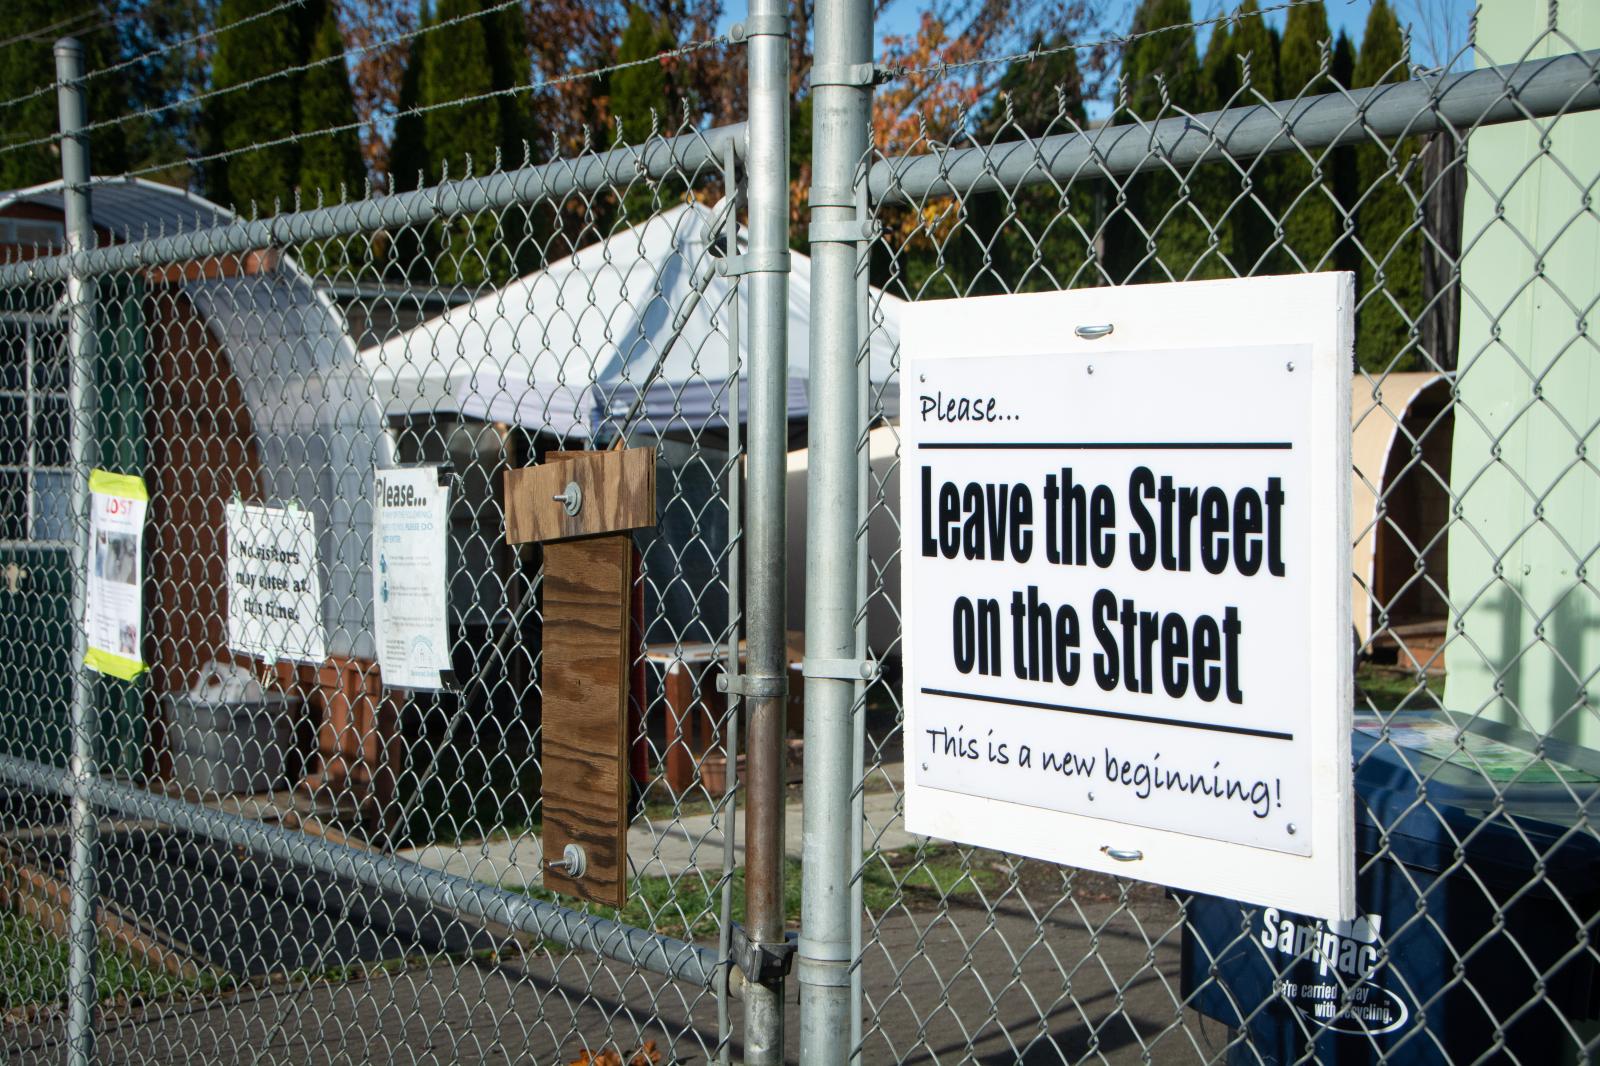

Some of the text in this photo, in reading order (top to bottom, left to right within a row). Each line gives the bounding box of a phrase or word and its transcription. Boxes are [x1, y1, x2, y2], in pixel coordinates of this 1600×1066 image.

[920, 392, 1020, 422] Please...
[921, 466, 1286, 577] Leave the Street
[239, 541, 255, 559] No
[953, 585, 1243, 705] on the Street
[926, 724, 1283, 819] This is a new beginning!
[1301, 982, 1338, 1000] carried
[1342, 986, 1370, 1004] way
[1314, 1001, 1393, 1025] with ecycling.
